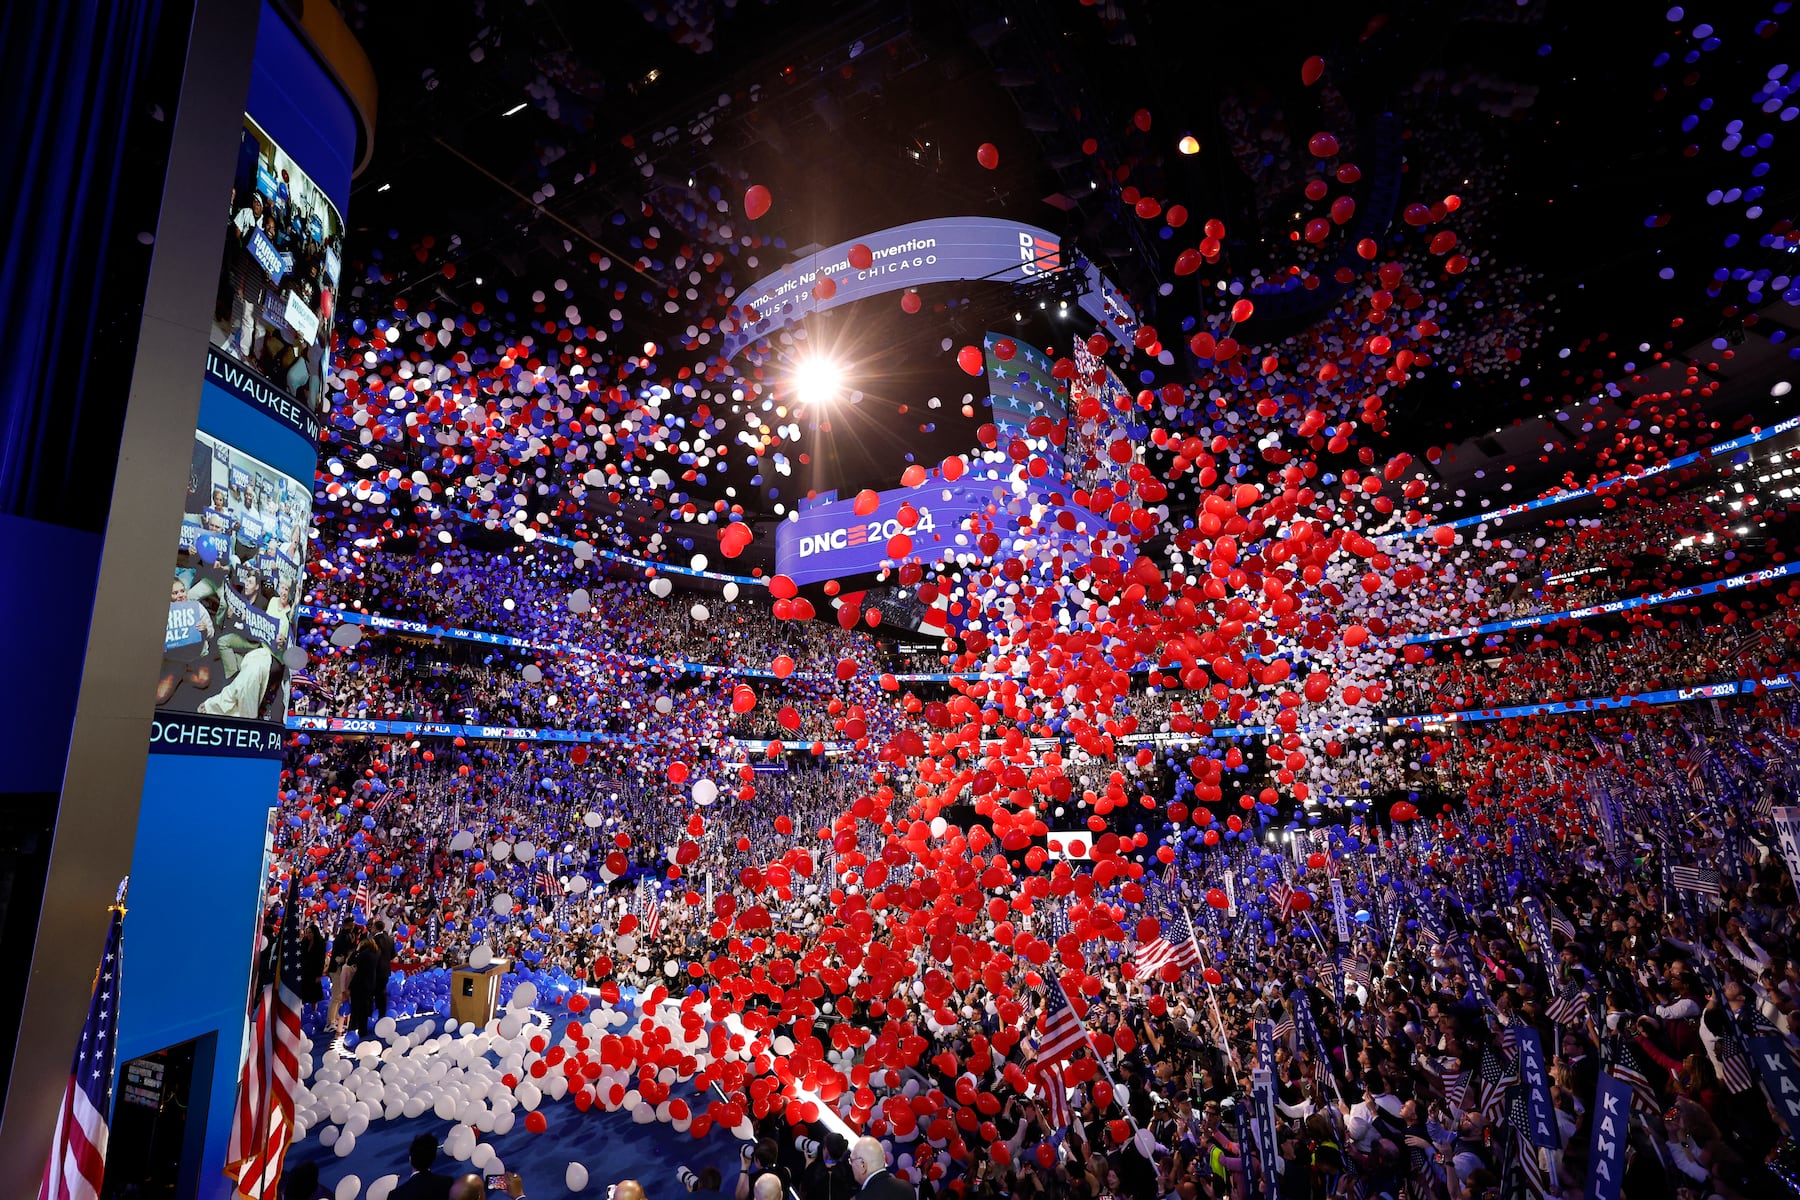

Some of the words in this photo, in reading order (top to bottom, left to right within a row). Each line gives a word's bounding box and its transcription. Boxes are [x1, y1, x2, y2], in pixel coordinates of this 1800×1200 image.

[254, 233, 282, 273] HARRIS
[255, 247, 275, 275] WALZ
[749, 279, 798, 309] moatic
[800, 258, 851, 286] Naonal
[872, 239, 936, 261] nvention
[795, 291, 809, 303] 19
[857, 255, 937, 281] CHICAGO
[206, 353, 304, 430] ILWAUKEE,
[306, 416, 318, 441] WI
[1711, 440, 1738, 453] MALA
[1774, 417, 1799, 434] DNC
[1481, 511, 1501, 521] DNC
[799, 527, 848, 558] DNC
[720, 573, 736, 583] 2024
[1547, 577, 1575, 586] FREDOM
[1759, 565, 1787, 580] 2024
[1658, 588, 1694, 600] KMALA
[166, 607, 195, 631] RRIS
[245, 608, 276, 640] HARRIS
[371, 616, 395, 628] DNC
[454, 629, 482, 640] KAMLA
[1511, 617, 1542, 627] KAMALA
[1569, 608, 1593, 619] DNC
[165, 627, 190, 643] ALZ
[249, 627, 272, 647] WALZ
[1712, 683, 1735, 696] 2024
[1761, 677, 1789, 687] KAMAL
[150, 721, 265, 752] OCHESTER,
[267, 732, 281, 751] PA
[343, 720, 377, 732] 2024
[416, 724, 450, 734] KAMALA
[1333, 886, 1347, 933] MARYLAND
[1409, 890, 1446, 935] KAMALA
[1458, 944, 1485, 1001] KAMALA
[1302, 999, 1330, 1065] KAMALA
[1259, 1031, 1272, 1072] KAMA
[1521, 1038, 1550, 1137] KAMALA
[1239, 1113, 1253, 1195] KAMALA
[1260, 1102, 1278, 1200] KAMALA
[1594, 1091, 1620, 1200] KAMAL
